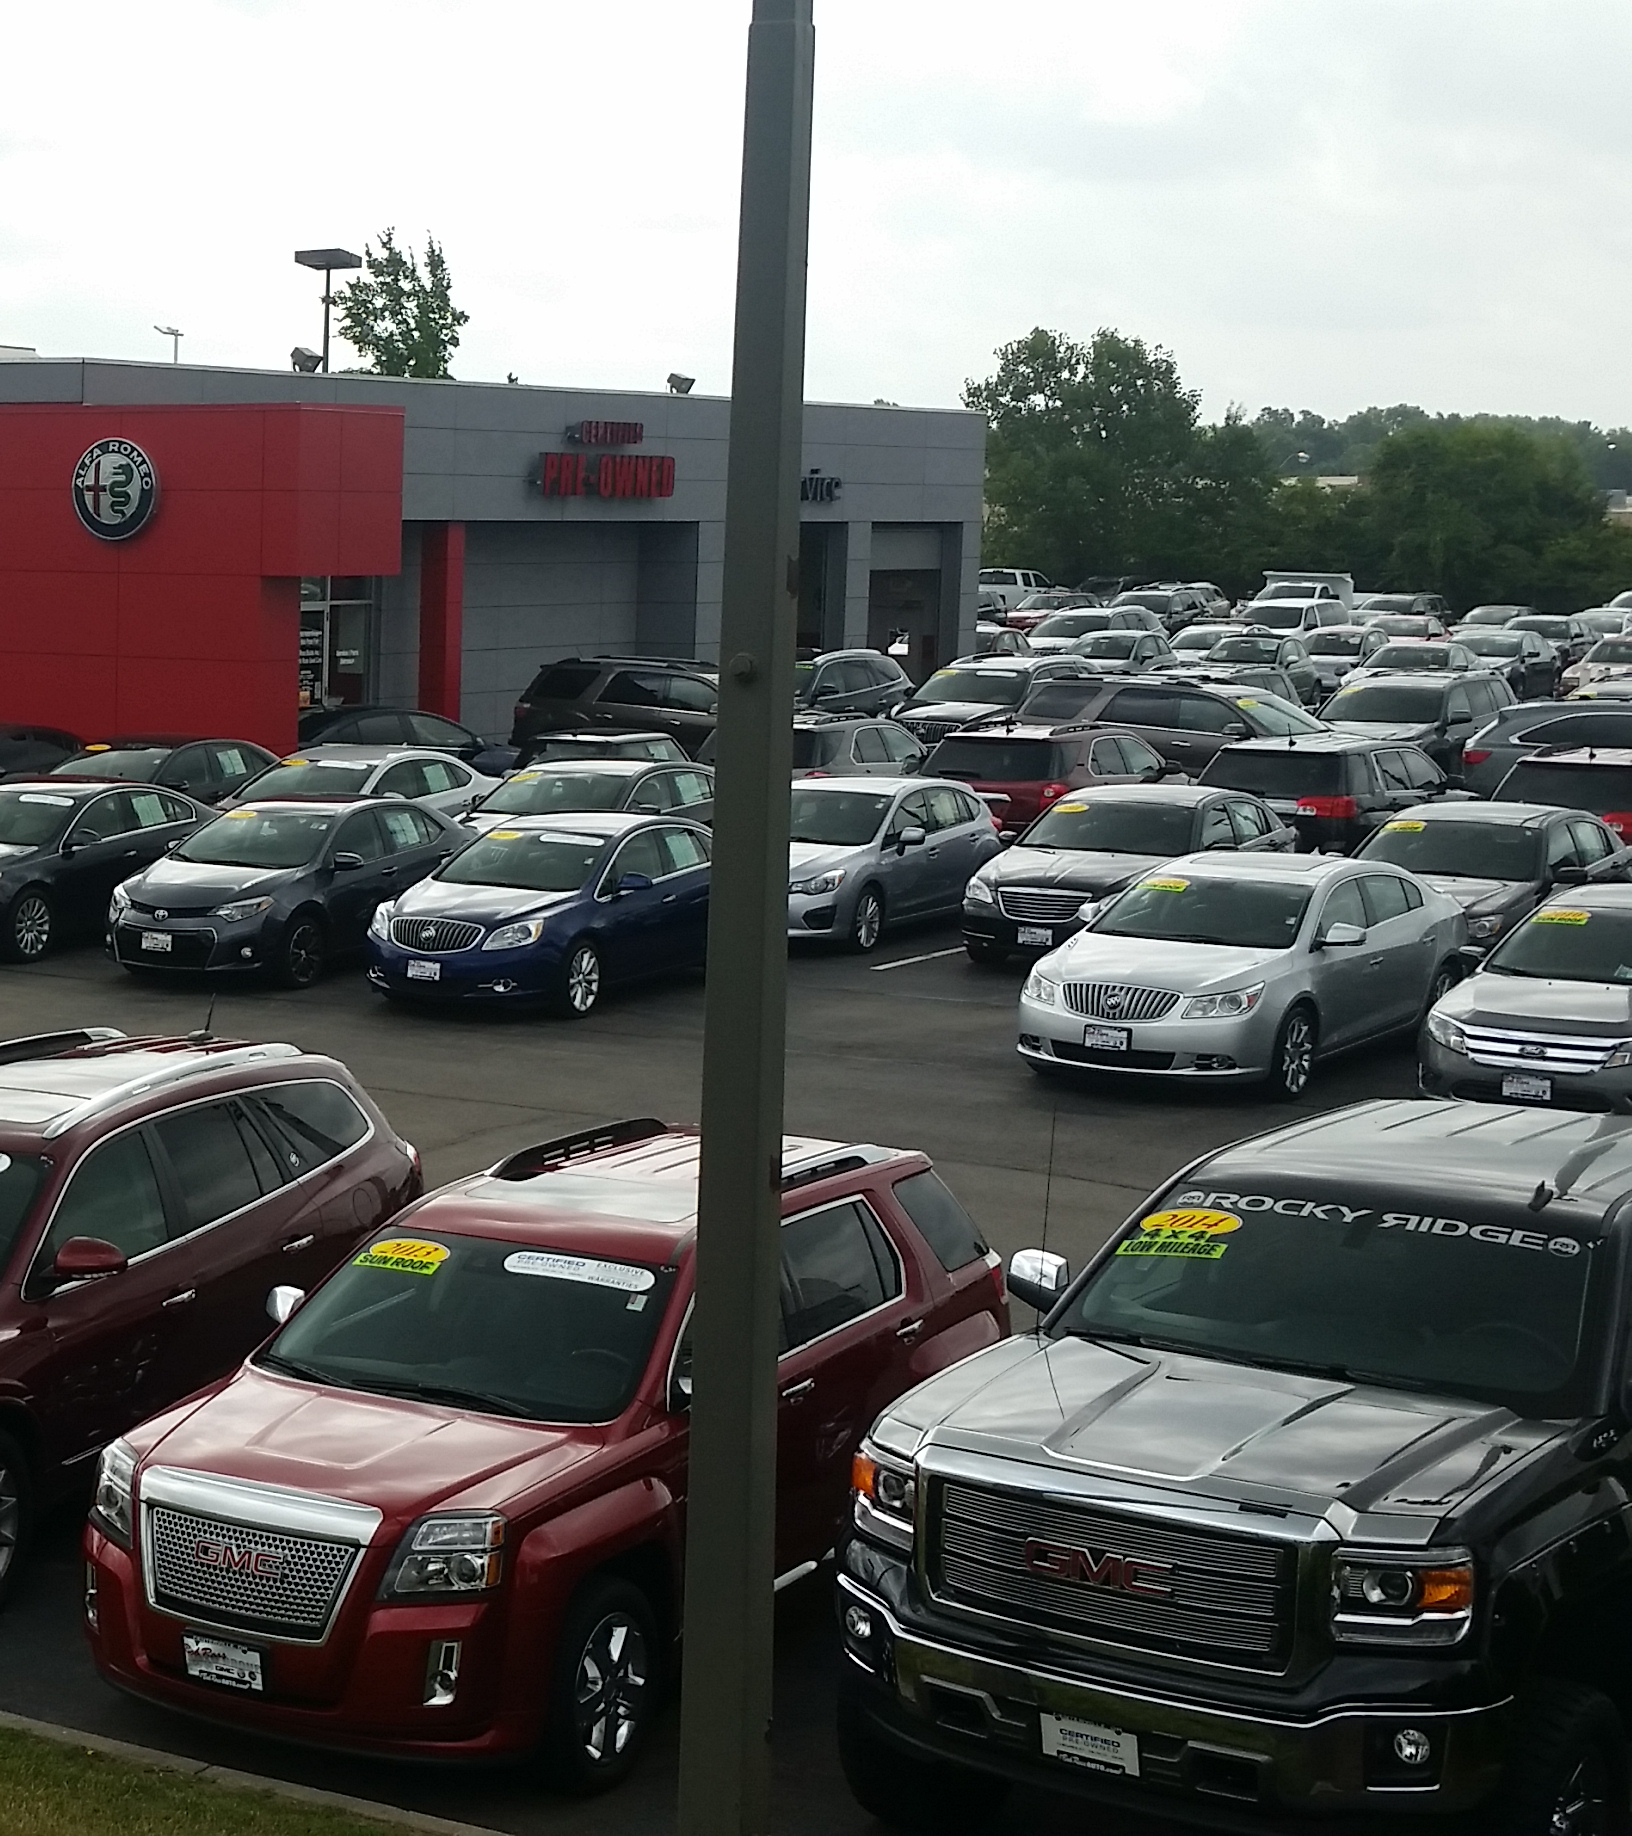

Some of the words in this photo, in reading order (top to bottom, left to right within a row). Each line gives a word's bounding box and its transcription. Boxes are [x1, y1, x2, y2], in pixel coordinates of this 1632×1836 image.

[581, 420, 644, 444] CERTIFIED
[75, 448, 103, 489] ALFA
[108, 441, 152, 490] ROMEO
[543, 453, 676, 498] PRE-OWNED
[1202, 1192, 1374, 1223] ROCKY
[1152, 1214, 1231, 1229] 2014
[378, 1242, 439, 1257] 2013
[1123, 1240, 1160, 1253] LOW
[1154, 1241, 1222, 1255] MILEAGE
[359, 1254, 394, 1265] SUN
[389, 1256, 435, 1270] ROOF
[517, 1254, 586, 1267] CERTIFIED
[596, 1262, 645, 1276] EXCLUSIVE
[587, 1275, 639, 1290] WARRANTIES
[194, 1538, 284, 1578] GMC
[1025, 1537, 1174, 1597] GMC
[201, 1647, 227, 1660] Ross
[215, 1665, 236, 1675] GMC
[1059, 1728, 1121, 1748] CERTIFIED
